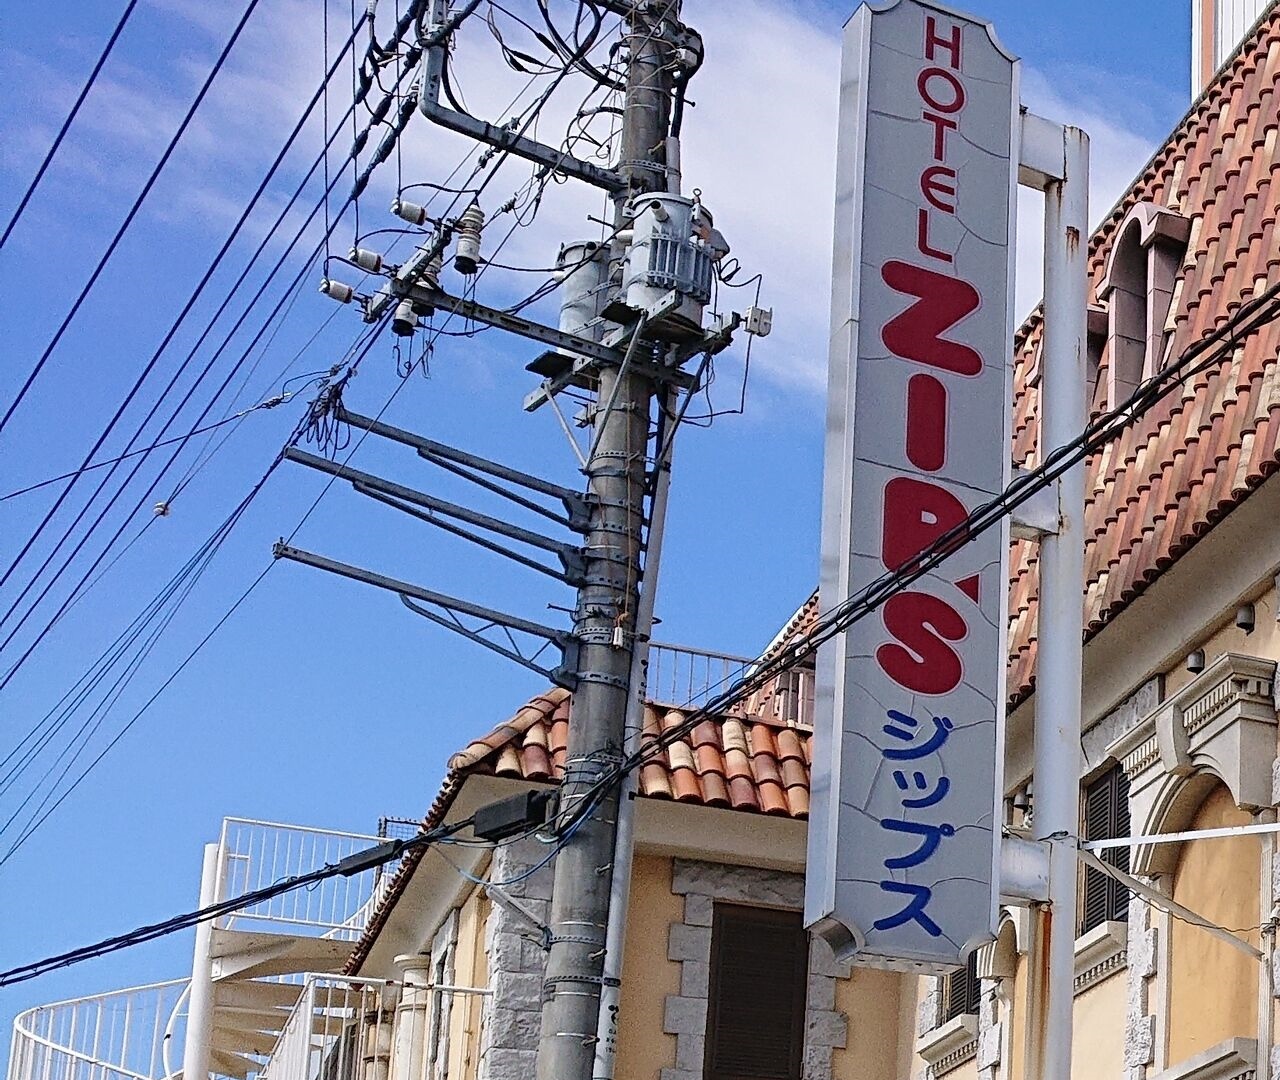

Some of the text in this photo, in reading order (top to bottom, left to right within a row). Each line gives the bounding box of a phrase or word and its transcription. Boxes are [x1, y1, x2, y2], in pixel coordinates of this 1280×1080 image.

[916, 15, 967, 263] HOTEL
[873, 709, 955, 938] ジップス
